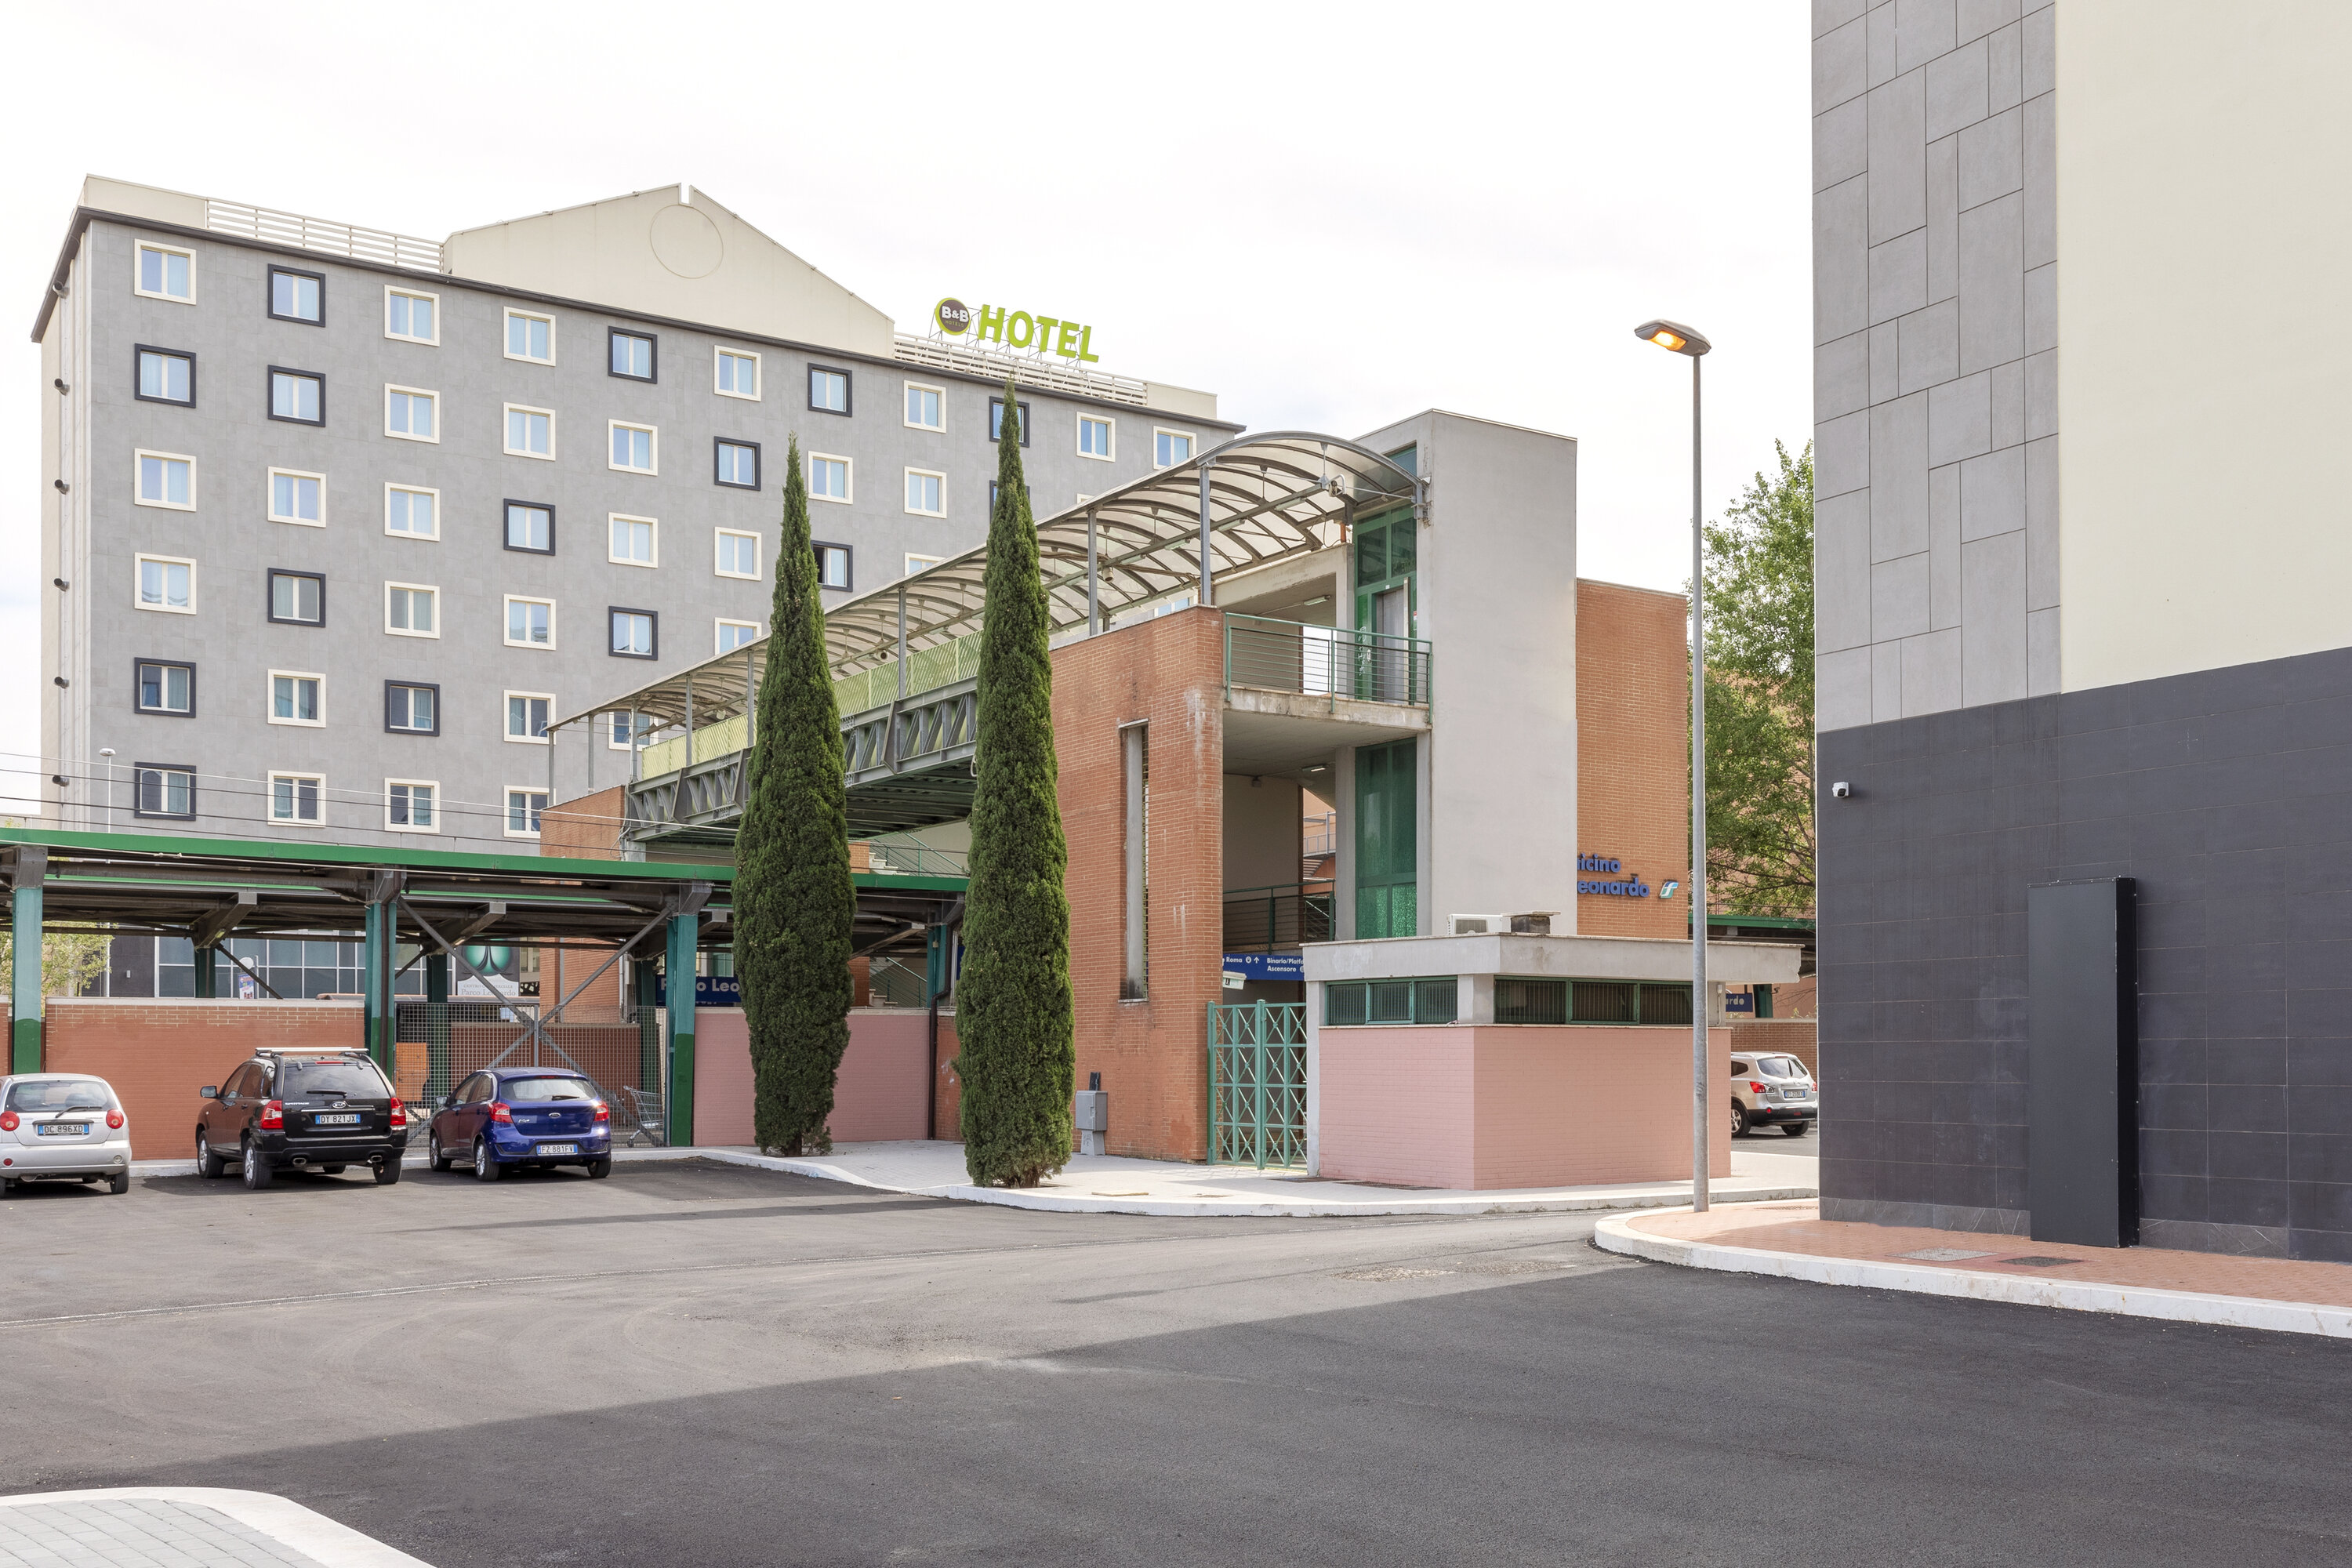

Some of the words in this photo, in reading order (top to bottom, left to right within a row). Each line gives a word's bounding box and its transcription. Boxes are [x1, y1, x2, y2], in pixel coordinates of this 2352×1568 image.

[942, 306, 969, 323] B&B
[978, 304, 1099, 362] HOTEL
[1577, 877, 1650, 897] eonardo
